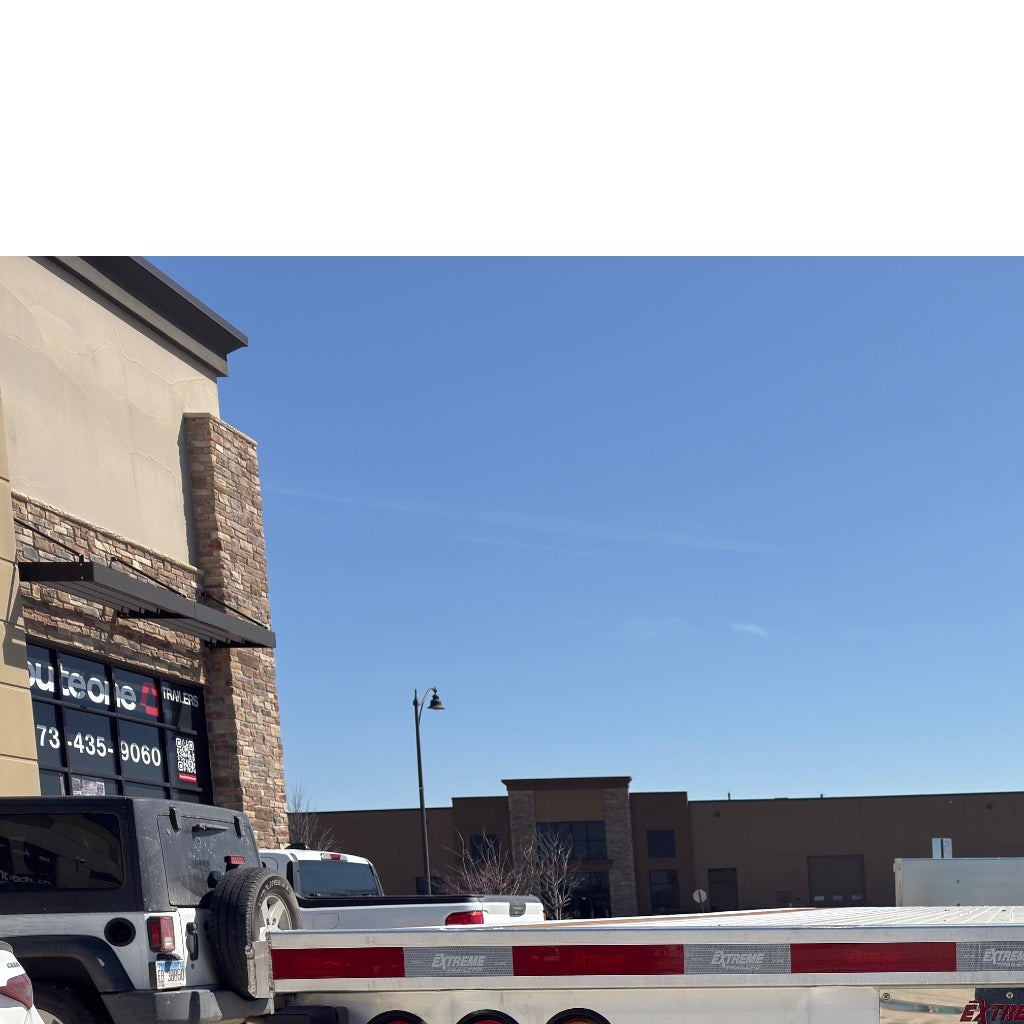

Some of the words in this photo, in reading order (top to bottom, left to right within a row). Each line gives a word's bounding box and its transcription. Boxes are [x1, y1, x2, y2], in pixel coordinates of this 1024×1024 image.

[162, 686, 199, 708] TRAILERS
[431, 953, 487, 971] EXTREME
[710, 950, 765, 968] EXTREME
